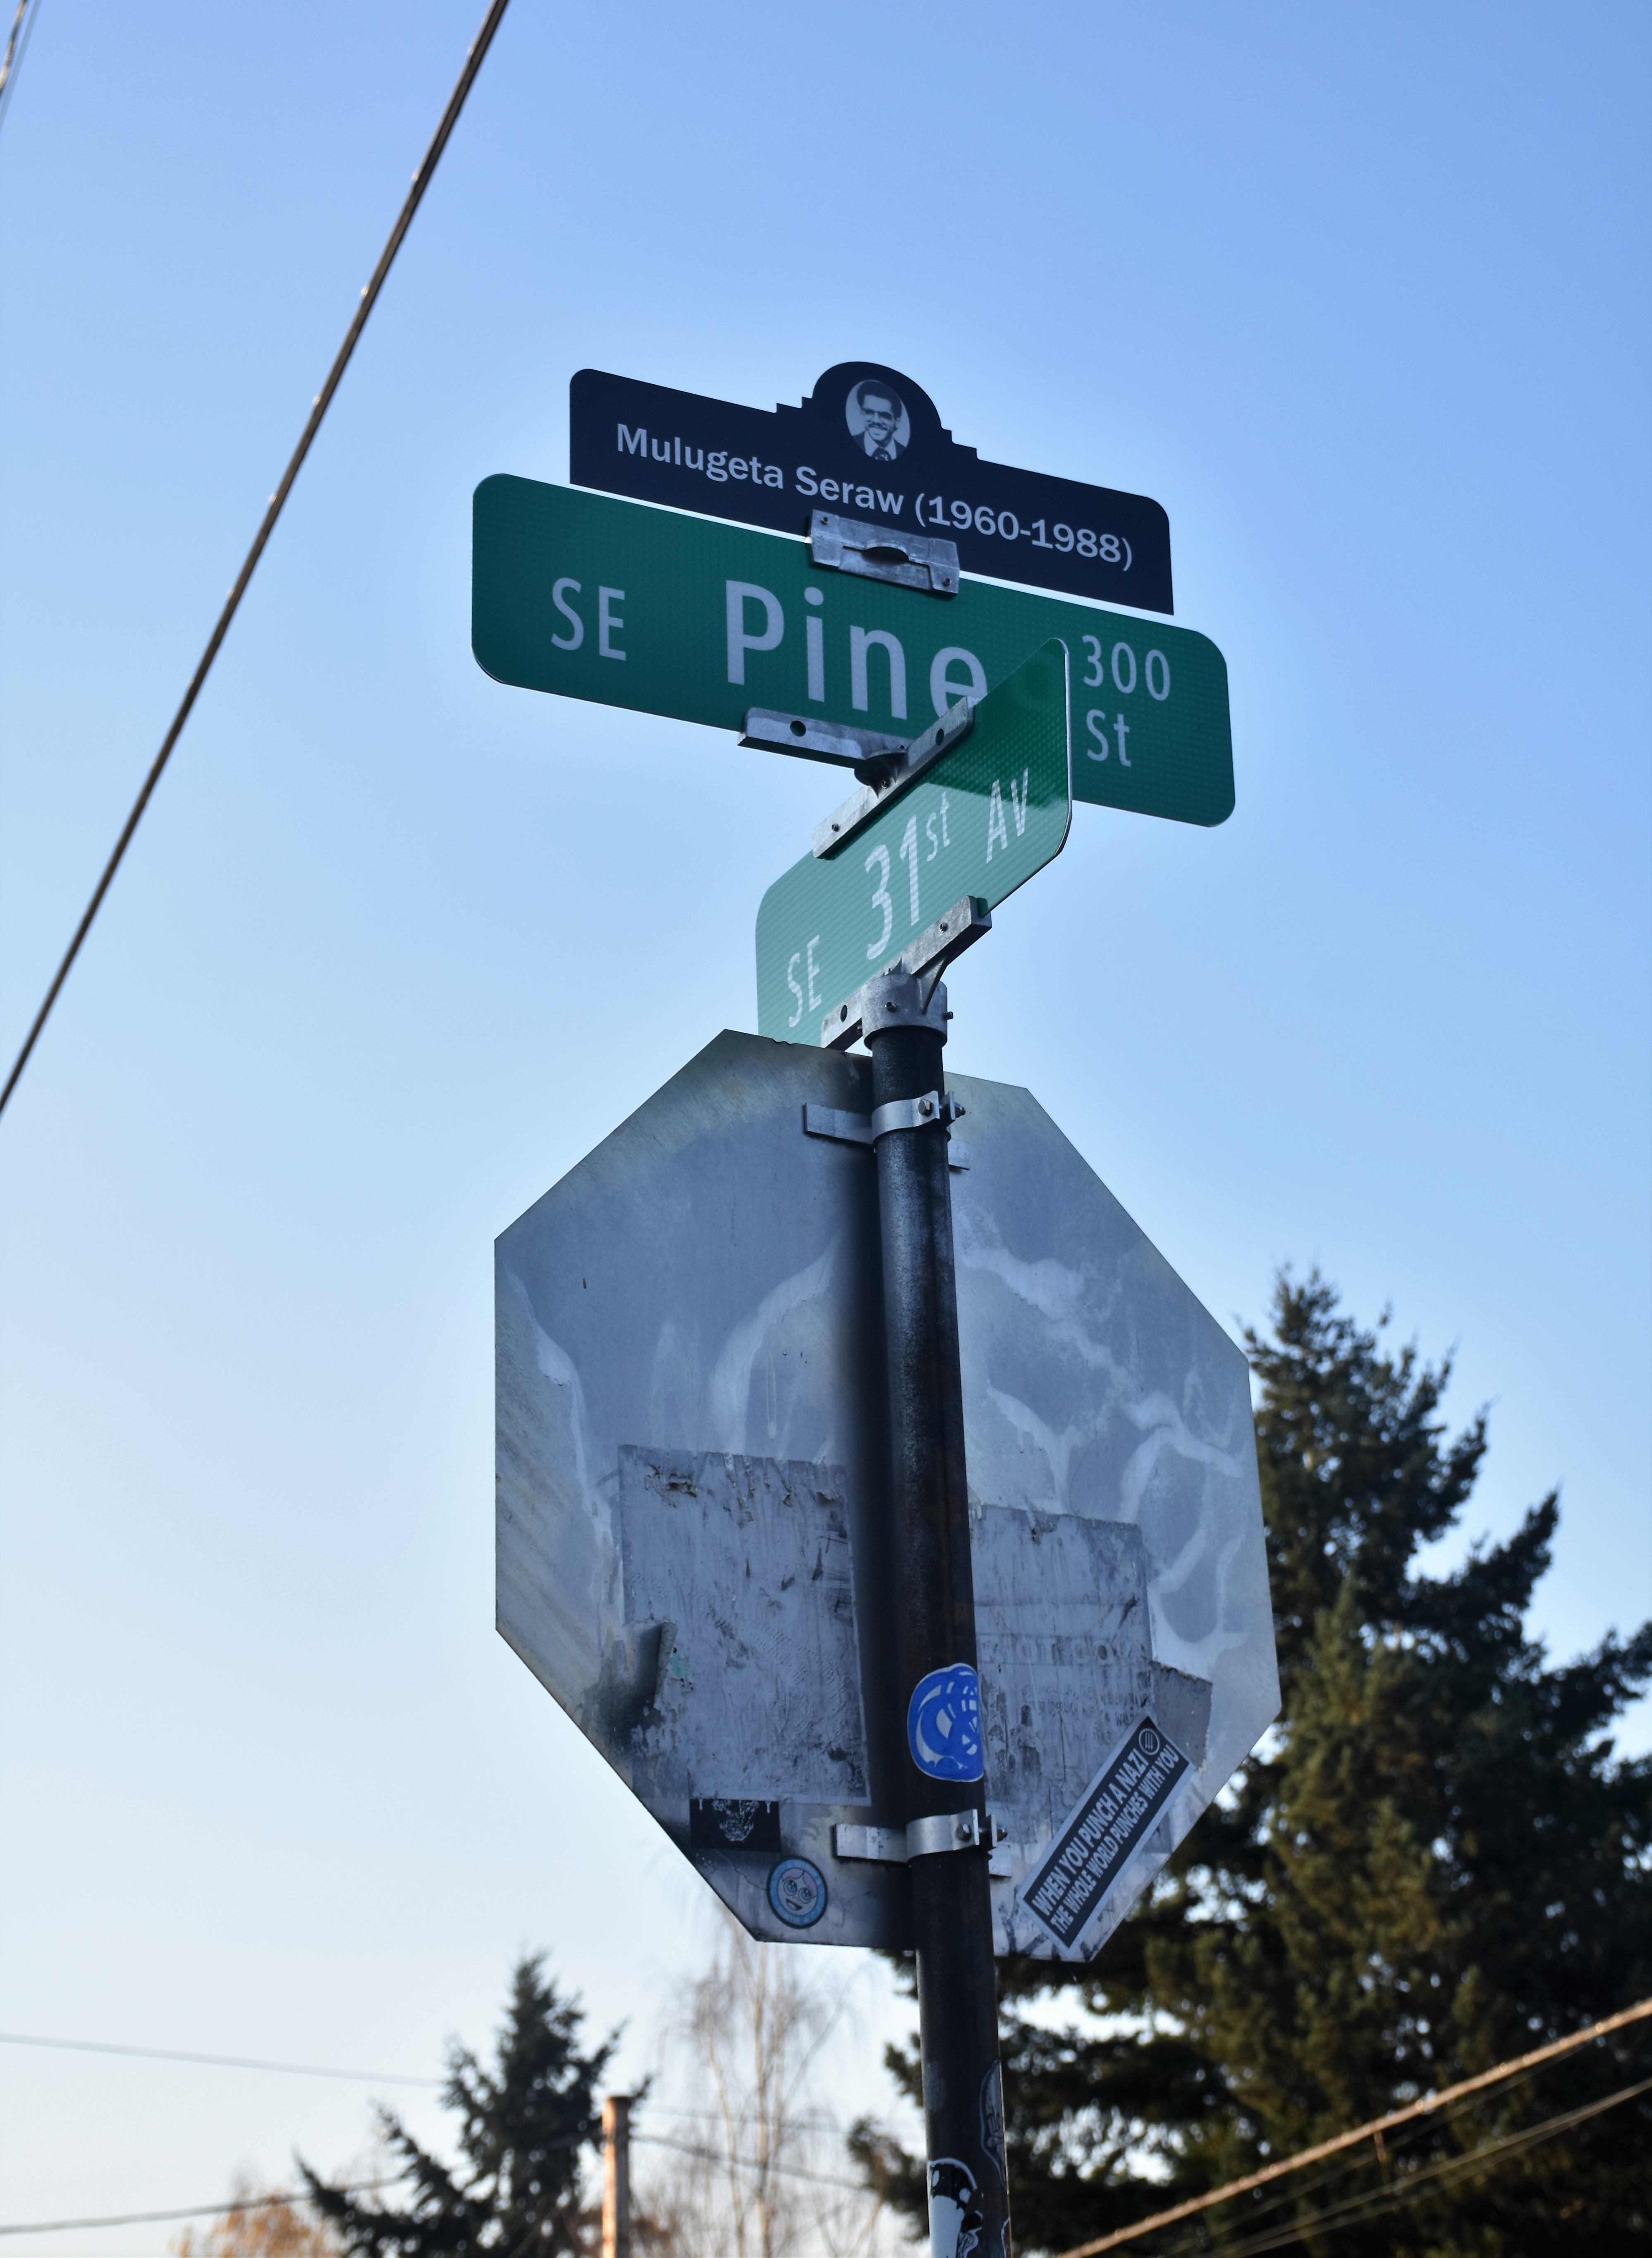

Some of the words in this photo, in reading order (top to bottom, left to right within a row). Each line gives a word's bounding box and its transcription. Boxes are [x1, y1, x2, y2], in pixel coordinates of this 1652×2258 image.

[617, 423, 784, 490] Mulugeta
[795, 466, 904, 515] Seraw
[915, 493, 1133, 572] (1960-1988)
[551, 577, 626, 661] SE
[725, 579, 988, 720] Pine
[1081, 635, 1171, 701] 300
[1086, 709, 1132, 767] St
[787, 935, 822, 1027] SE
[986, 767, 1029, 864] AV
[1108, 1782, 1128, 1805] A
[1114, 1748, 1149, 1792] NAZI
[1050, 1905, 1074, 1934] THE
[1062, 1869, 1097, 1914] WHOLE
[1085, 1835, 1119, 1879] WORLD
[1109, 1791, 1149, 1845] PUNCHES
[1138, 1765, 1166, 1800] WITH
[1155, 1744, 1179, 1774] YOU
[1077, 1792, 1119, 1848] PUNCH
[1058, 1837, 1089, 1875] YOU
[1032, 1866, 1071, 1916] WHEN
